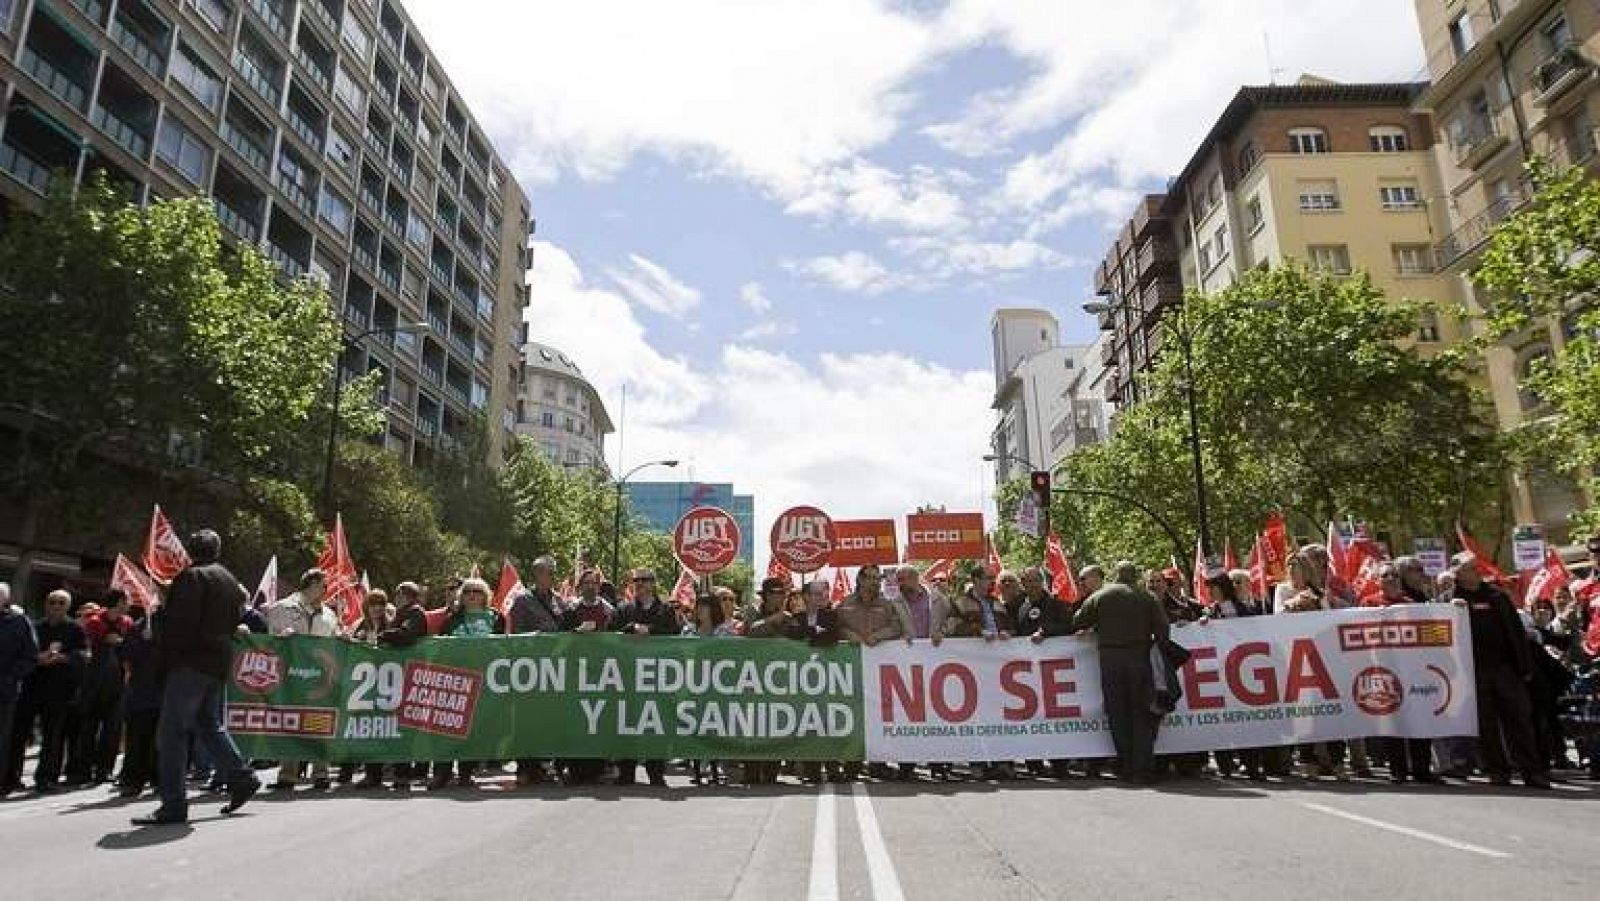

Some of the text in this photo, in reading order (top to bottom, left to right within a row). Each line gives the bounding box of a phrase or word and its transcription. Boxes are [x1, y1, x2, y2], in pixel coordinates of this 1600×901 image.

[683, 516, 728, 542] UGT
[780, 516, 828, 542] UGT
[912, 530, 960, 543] CCOO
[1343, 624, 1418, 647] CCOO
[241, 652, 280, 673] UGT
[347, 662, 403, 711] 29
[412, 668, 474, 693] QUIEREN
[486, 654, 854, 697] CON LA EDUCACIÓN
[879, 638, 1341, 723] NO SE EGA
[405, 685, 468, 712] ACABAR
[228, 708, 300, 730] CCOO
[343, 715, 402, 739] ABRIL
[403, 704, 464, 729] CON TODO
[579, 701, 854, 738] Y LA SANIDAD
[882, 725, 957, 738] PLATAFORMA
[1030, 722, 1053, 735] DEL
[1055, 720, 1099, 734] ESTADO
